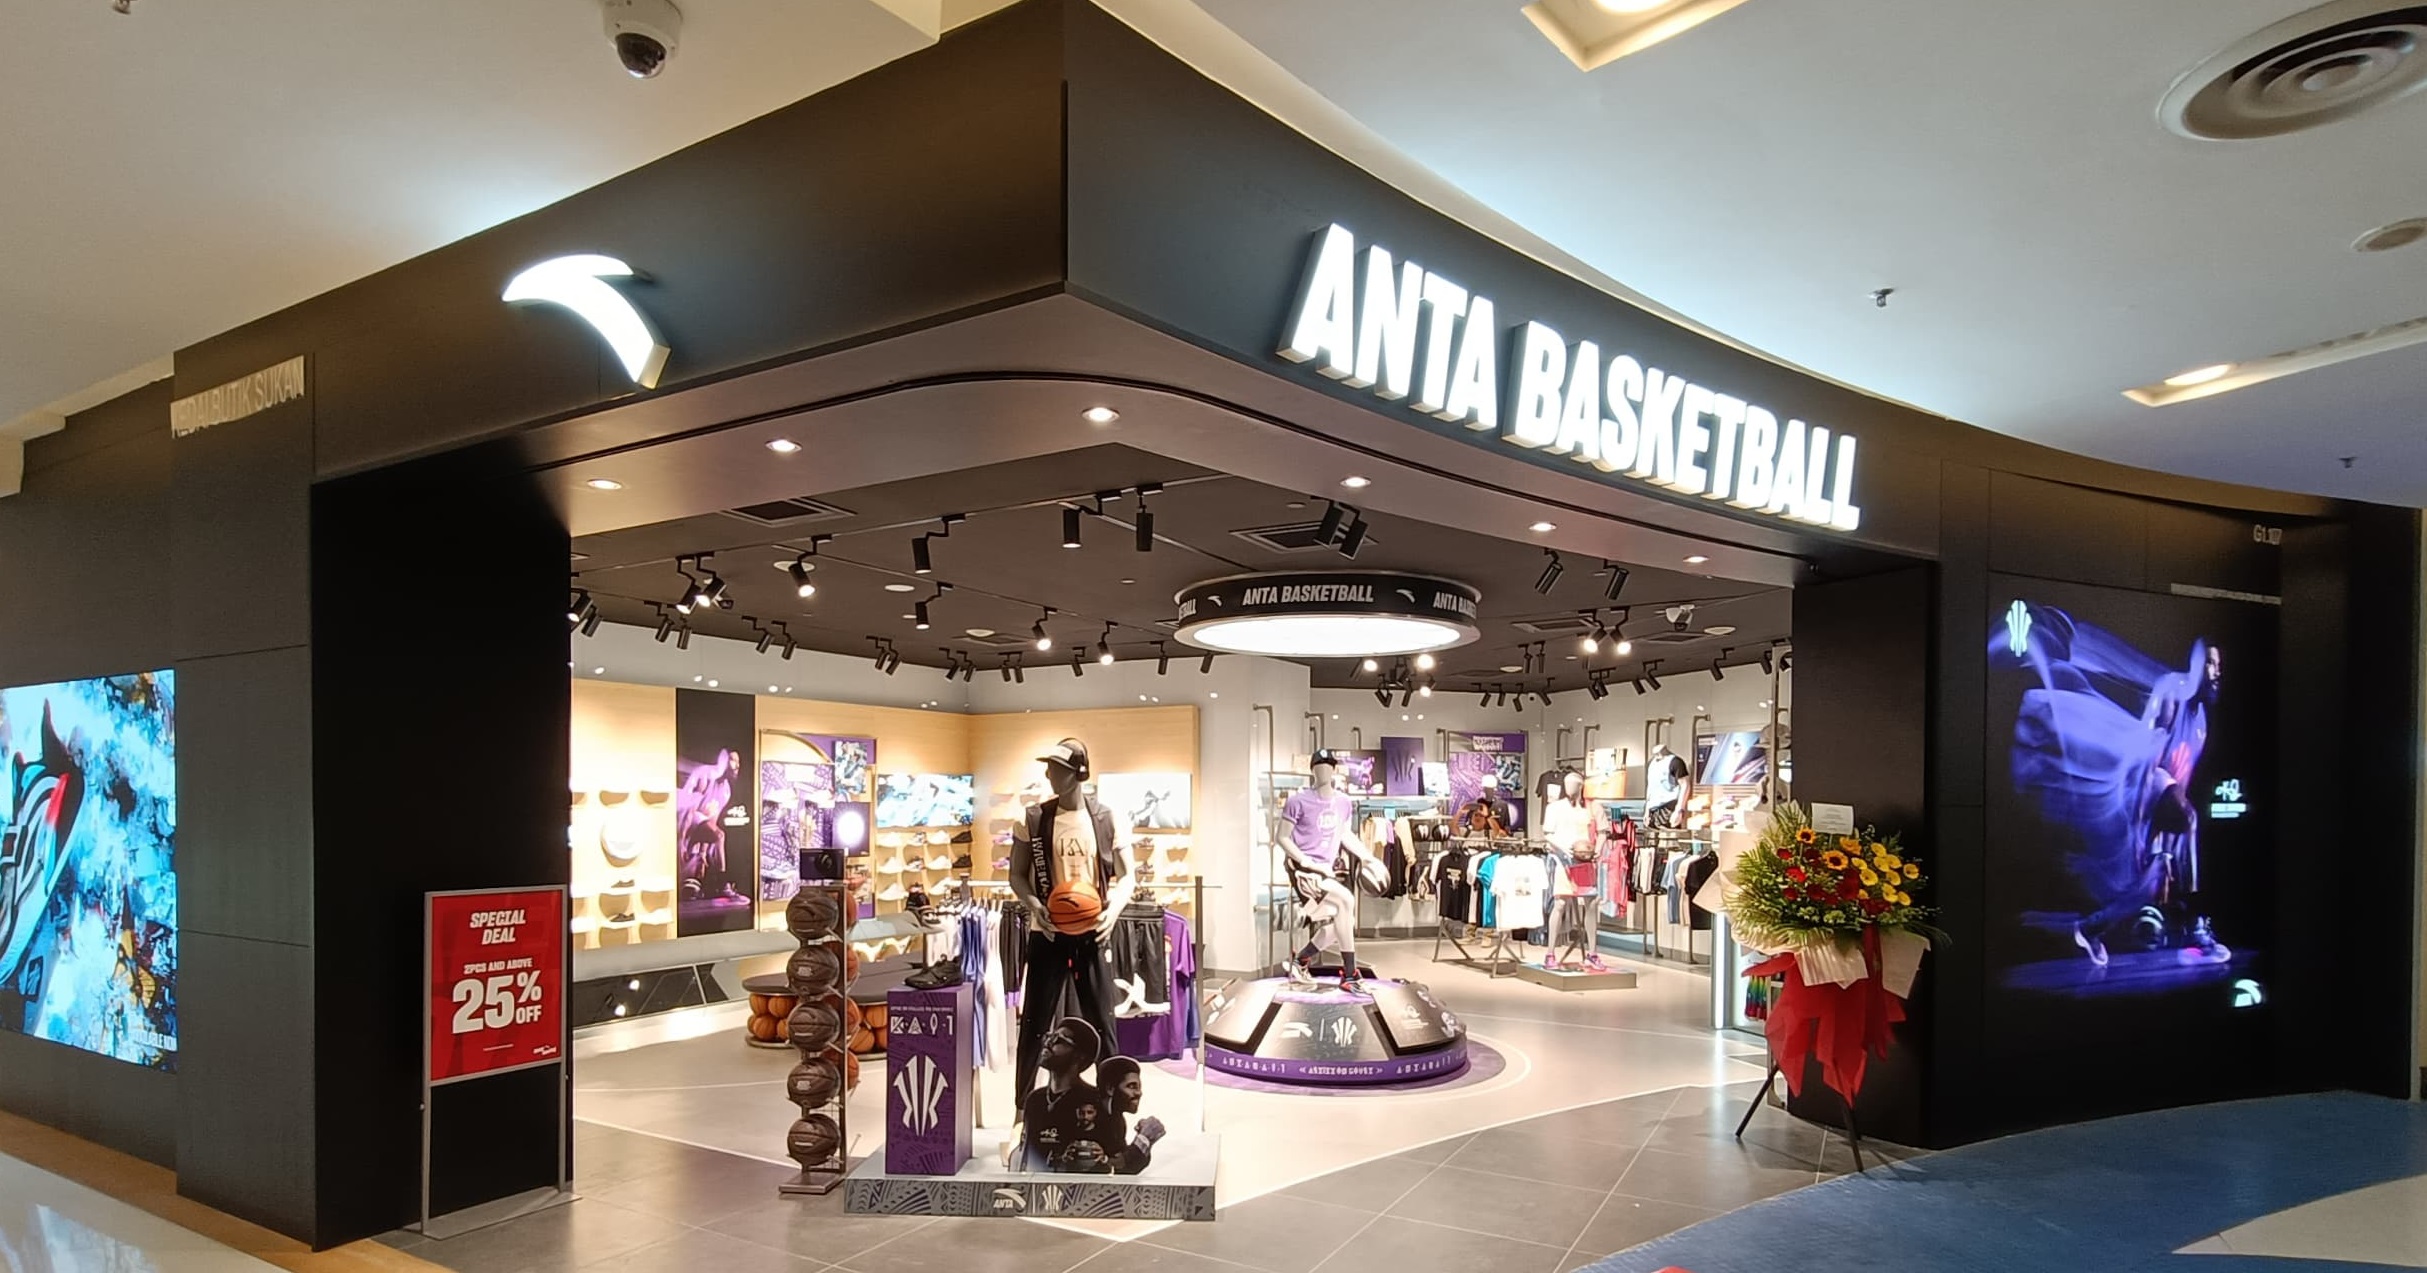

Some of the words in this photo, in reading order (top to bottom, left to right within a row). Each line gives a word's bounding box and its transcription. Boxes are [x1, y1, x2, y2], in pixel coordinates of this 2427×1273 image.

[254, 355, 304, 411] SUKAN
[1282, 222, 1499, 432] ANTA
[1508, 320, 1861, 531] BASKETBALL
[1242, 587, 1278, 605] ANTA
[1281, 585, 1374, 602] BASKETBALL
[1433, 591, 1457, 611] ANTA
[470, 909, 526, 928] SPECIAL
[482, 927, 516, 945] DEAL
[464, 962, 486, 974] 2PCS
[488, 960, 505, 972] AND
[507, 957, 533, 969] ABOVE
[516, 1005, 542, 1024] OFF
